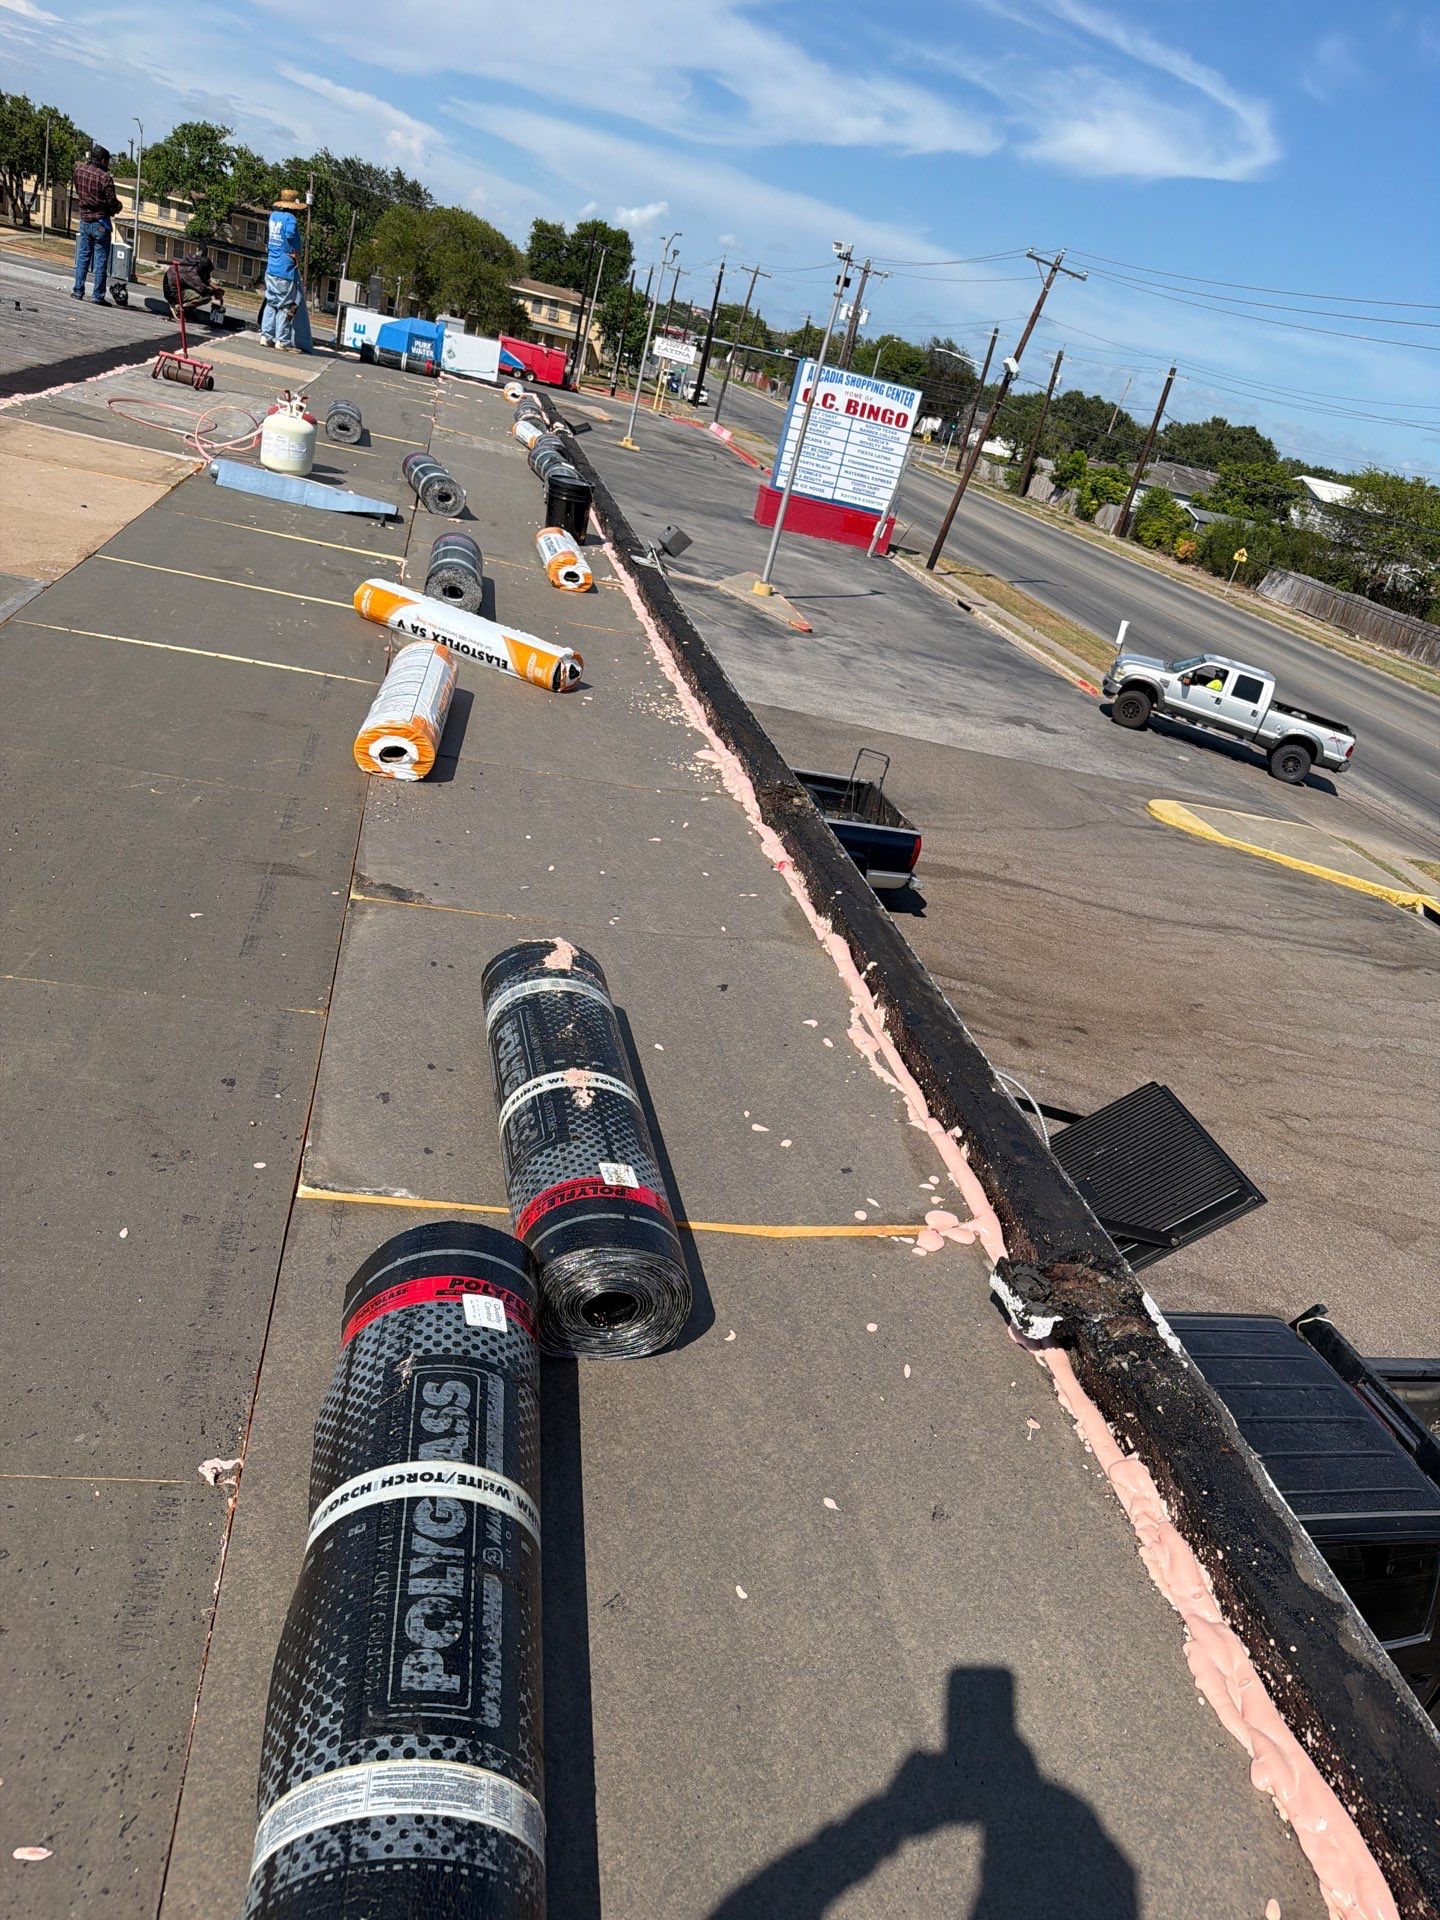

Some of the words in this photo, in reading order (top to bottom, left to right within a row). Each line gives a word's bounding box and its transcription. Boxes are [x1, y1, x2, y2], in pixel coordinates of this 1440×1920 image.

[414, 340, 431, 349] PURE
[411, 346, 434, 357] WATER
[807, 365, 844, 384] ACADIA
[845, 375, 885, 396] SHOPPING
[886, 386, 915, 409] CENTER
[845, 391, 862, 399] HOME
[845, 399, 908, 428] BINGO
[818, 416, 842, 426] COMPANY
[809, 427, 829, 435] MARKET
[860, 428, 878, 436] BARBER
[879, 432, 900, 441] COLLEGE
[859, 440, 880, 449] NOVELTY
[822, 478, 835, 486] SHOP
[397, 619, 406, 630] V
[410, 623, 427, 637] SA
[432, 631, 508, 669] ELASTOFLEX
[355, 1287, 409, 1323] POLYGLASS
[381, 1471, 511, 1502] WHITE/TORCH
[401, 1381, 472, 1692] POLYGASS
